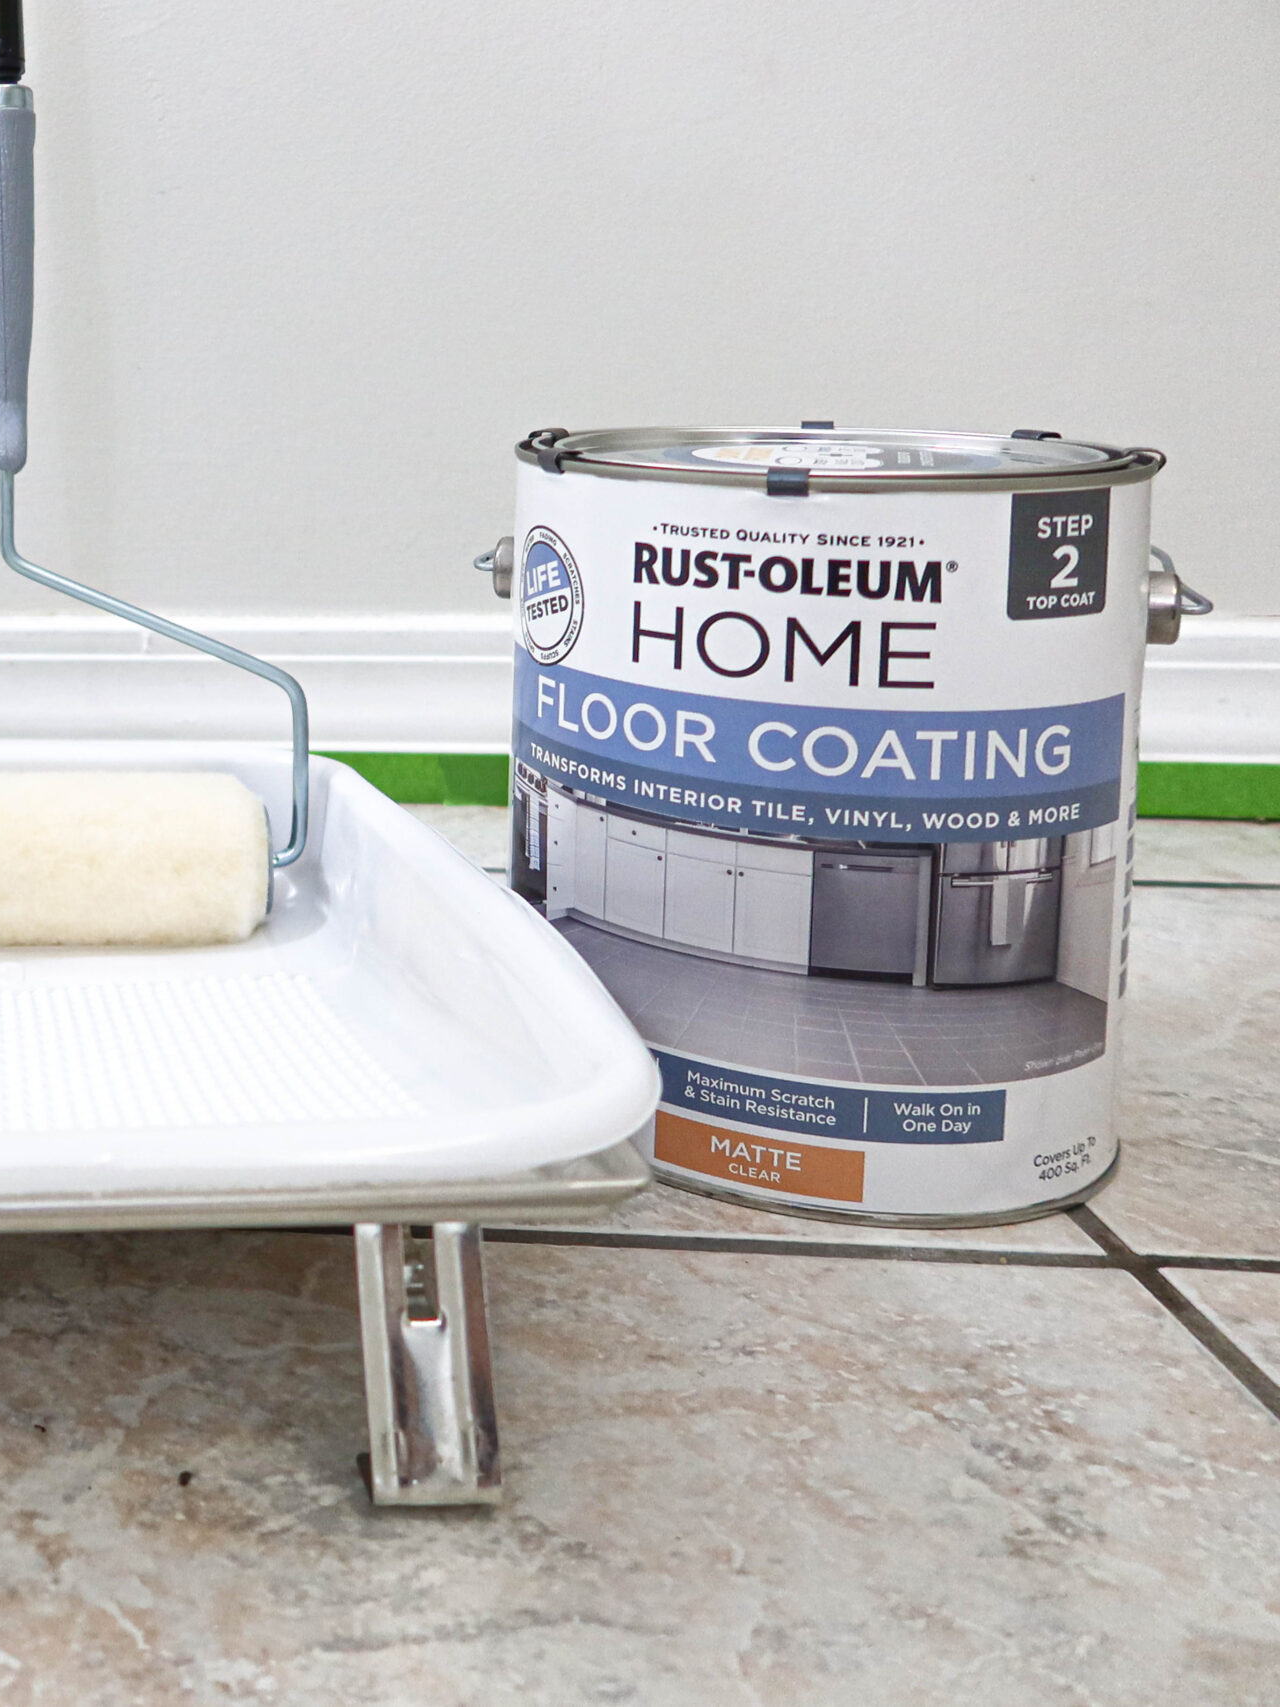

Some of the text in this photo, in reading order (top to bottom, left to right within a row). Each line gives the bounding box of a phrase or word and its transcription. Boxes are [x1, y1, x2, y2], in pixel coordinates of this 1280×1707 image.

[660, 523, 915, 548] TRUSTED QUALITY SINCE 1921
[1037, 513, 1094, 539] STEP
[526, 559, 562, 597] LIFE
[1050, 544, 1079, 589] 2
[526, 594, 569, 622] TESTED
[1026, 591, 1096, 610] TOP COAT
[632, 600, 937, 689] HOME
[537, 674, 1071, 781] FLOOR COATING
[531, 742, 1081, 832] TRANSFORMS INTERIOR TILE, VINYL, WOOD & MORE
[687, 1069, 835, 1110] Maximum Scratch
[684, 1085, 837, 1126] & Stain Resistance
[893, 1102, 981, 1117] Walk On in
[902, 1119, 972, 1135] One Day
[710, 1135, 802, 1172] MATTE
[1033, 1149, 1072, 1167] Covers
[1073, 1142, 1086, 1156] Up
[728, 1162, 781, 1183] CLEAR
[1038, 1165, 1062, 1181] 400
